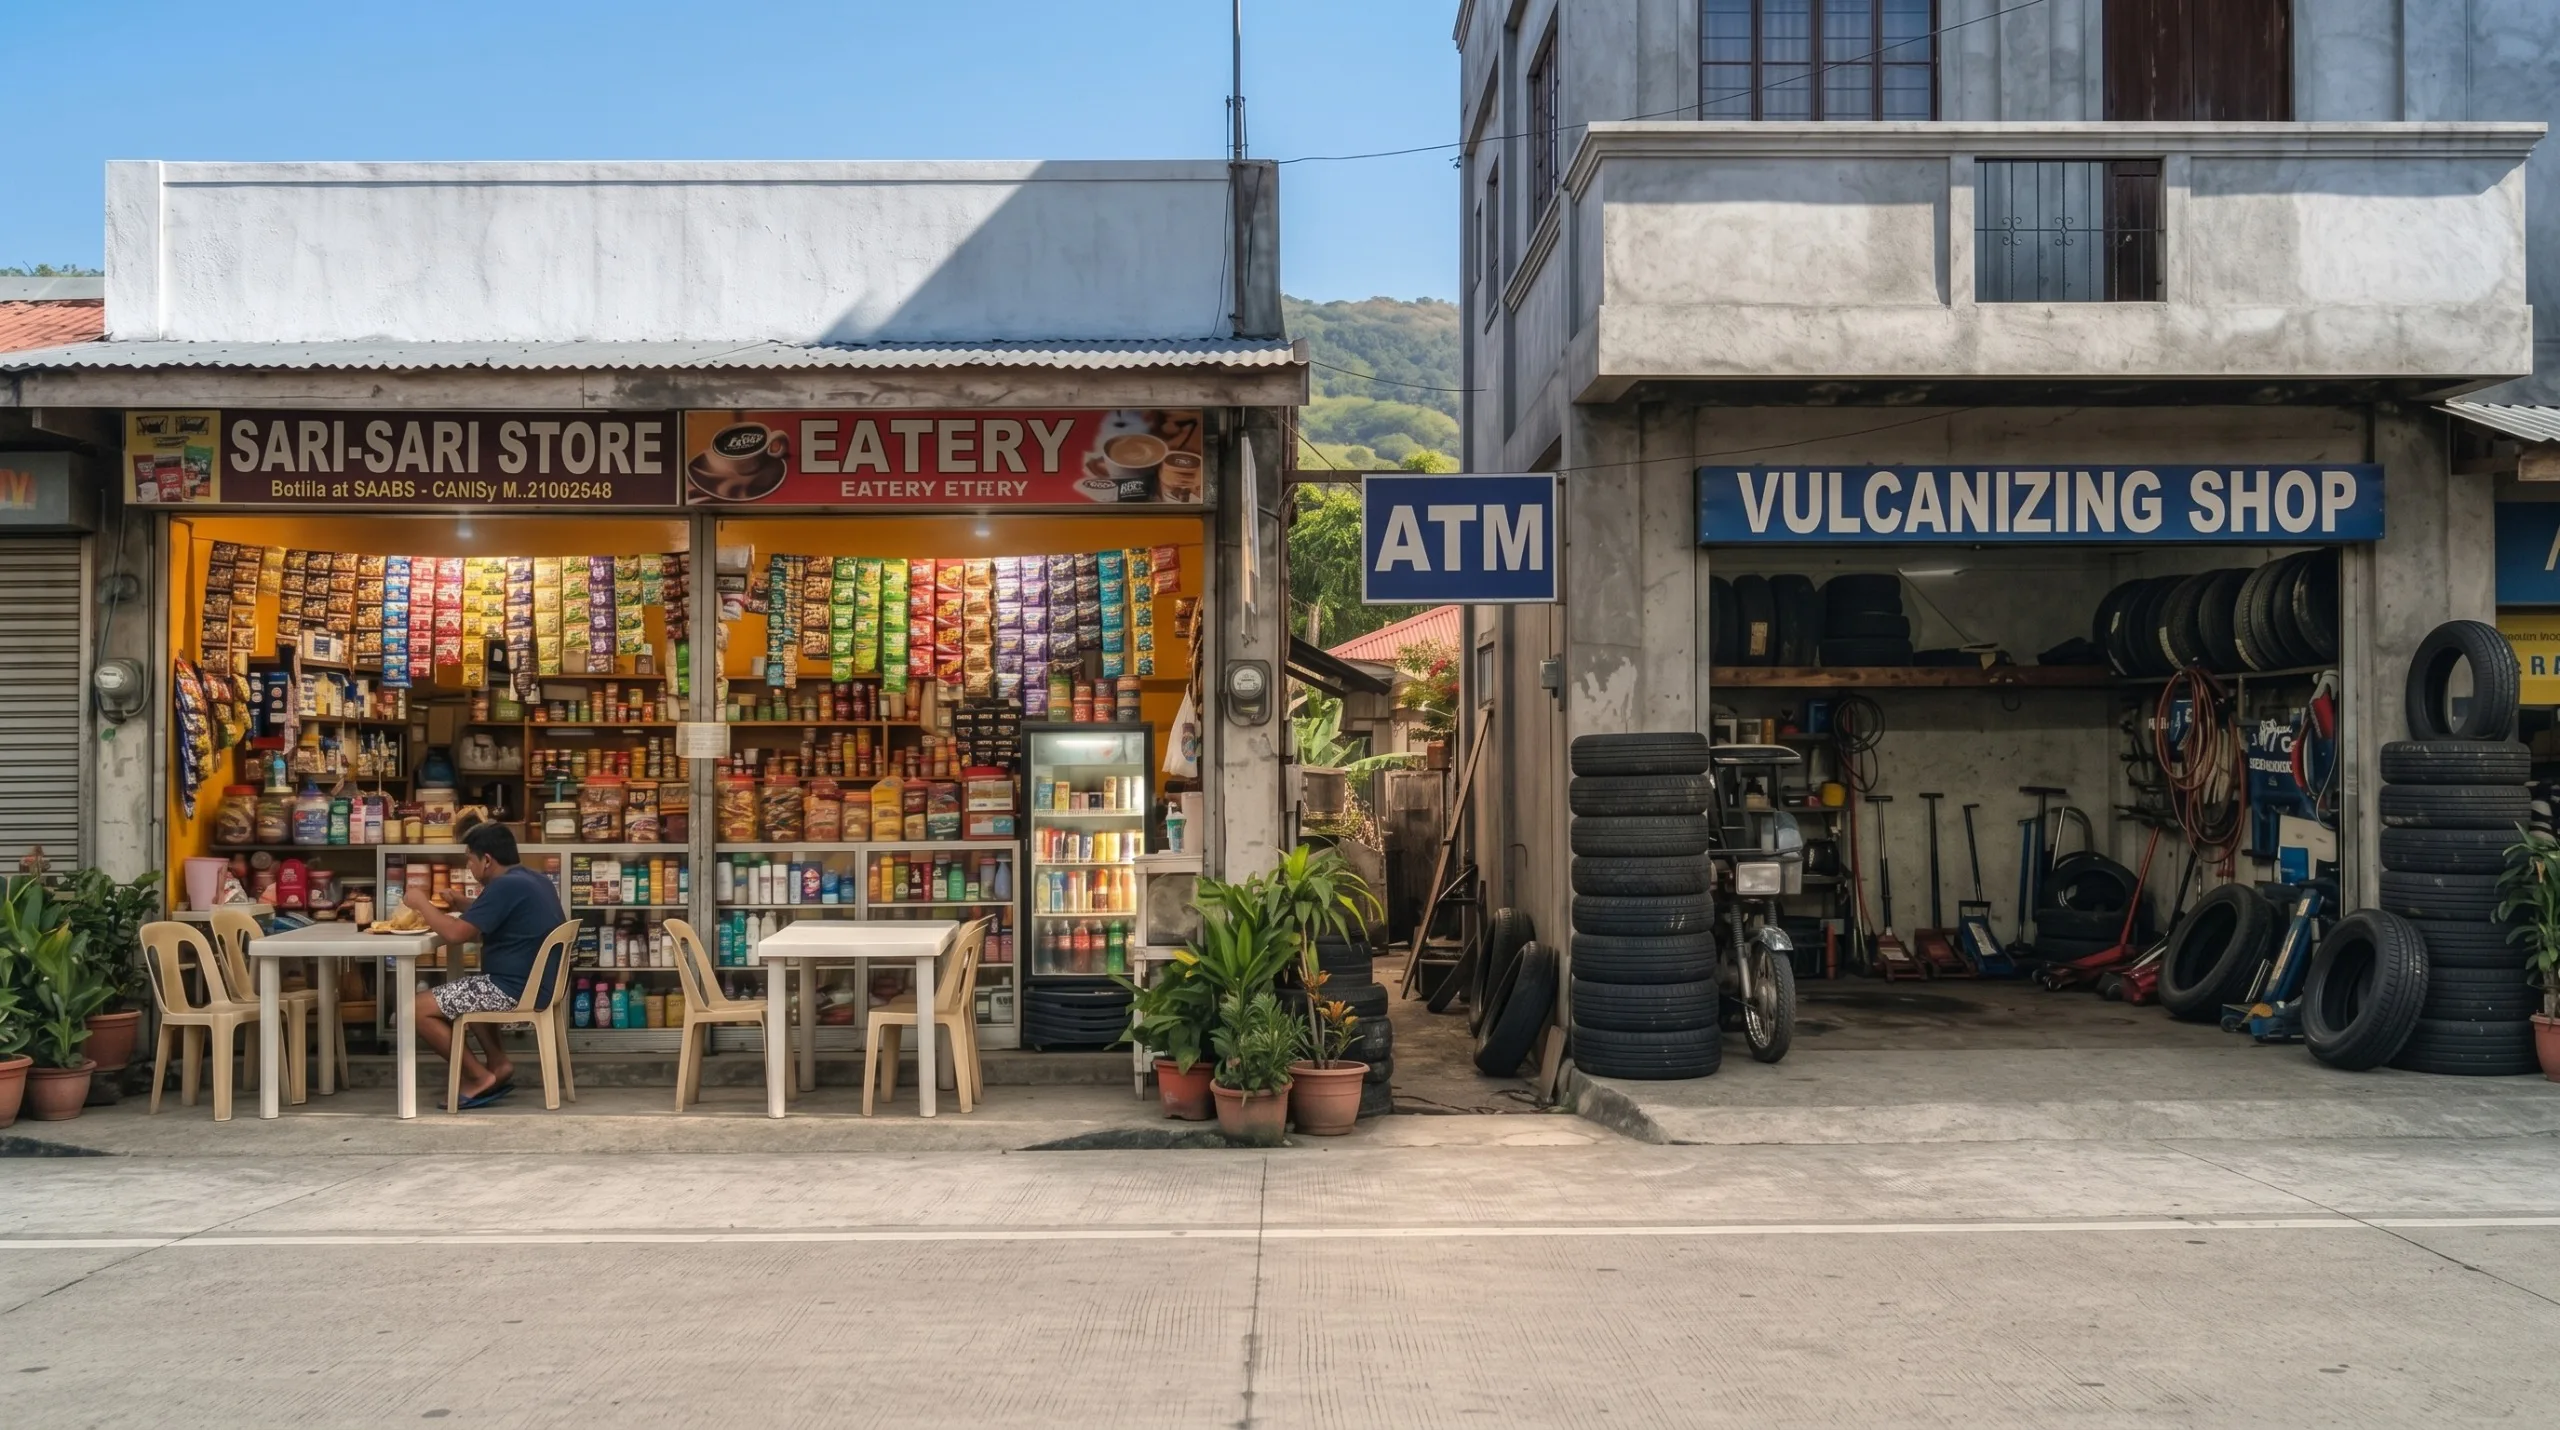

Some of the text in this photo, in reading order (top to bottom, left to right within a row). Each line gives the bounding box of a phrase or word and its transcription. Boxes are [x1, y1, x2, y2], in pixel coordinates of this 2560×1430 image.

[230, 419, 663, 475] SARI-SARI STORE
[800, 419, 1075, 473] EATERY
[332, 481, 349, 498] at
[354, 480, 416, 498] SAABS
[432, 480, 497, 503] CANISy
[841, 480, 937, 497] EATERY
[1736, 469, 2357, 534] VULCANIZING SHOP
[1374, 503, 1544, 572] ATM
